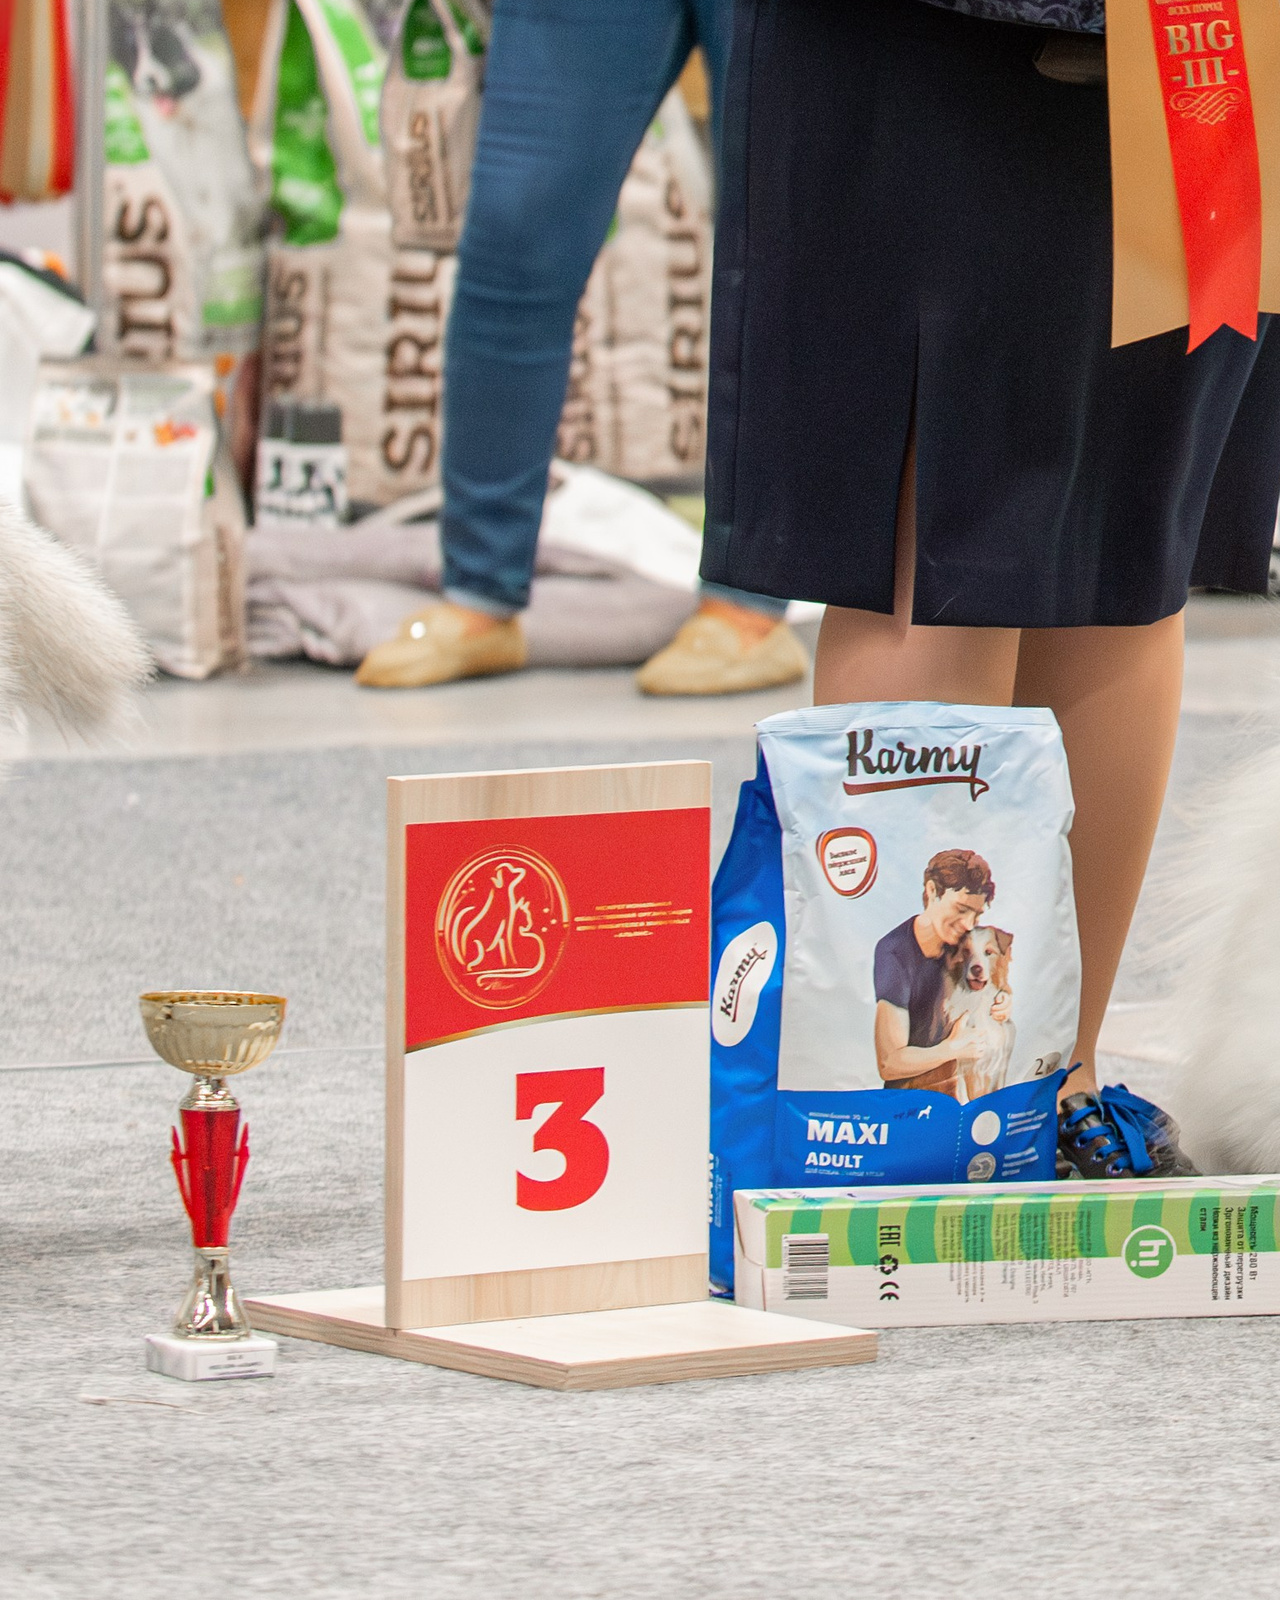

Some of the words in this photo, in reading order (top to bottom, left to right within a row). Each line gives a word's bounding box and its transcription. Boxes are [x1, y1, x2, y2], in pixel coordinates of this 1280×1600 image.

[1164, 19, 1235, 56] BIG
[116, 195, 174, 359] IUS
[383, 252, 440, 476] SIRIU
[846, 729, 982, 802] Karmy
[720, 945, 767, 1018] Karmy
[516, 1066, 610, 1212] 3
[806, 1119, 889, 1145] MAXI
[805, 1151, 863, 1170] ADULT
[1200, 1208, 1208, 1232] стали
[1224, 1207, 1234, 1268] Эргономичный
[1236, 1206, 1246, 1239] Защита
[1249, 1206, 1259, 1249] Мощность
[1131, 1239, 1167, 1267] hi
[1237, 1241, 1245, 1250] от
[1249, 1252, 1258, 1268] 280
[1210, 1242, 1221, 1301] нержавеющей
[1223, 1271, 1234, 1300] дизайн
[1235, 1253, 1245, 1300] перегрузки
[1249, 1271, 1258, 1281] Вт
